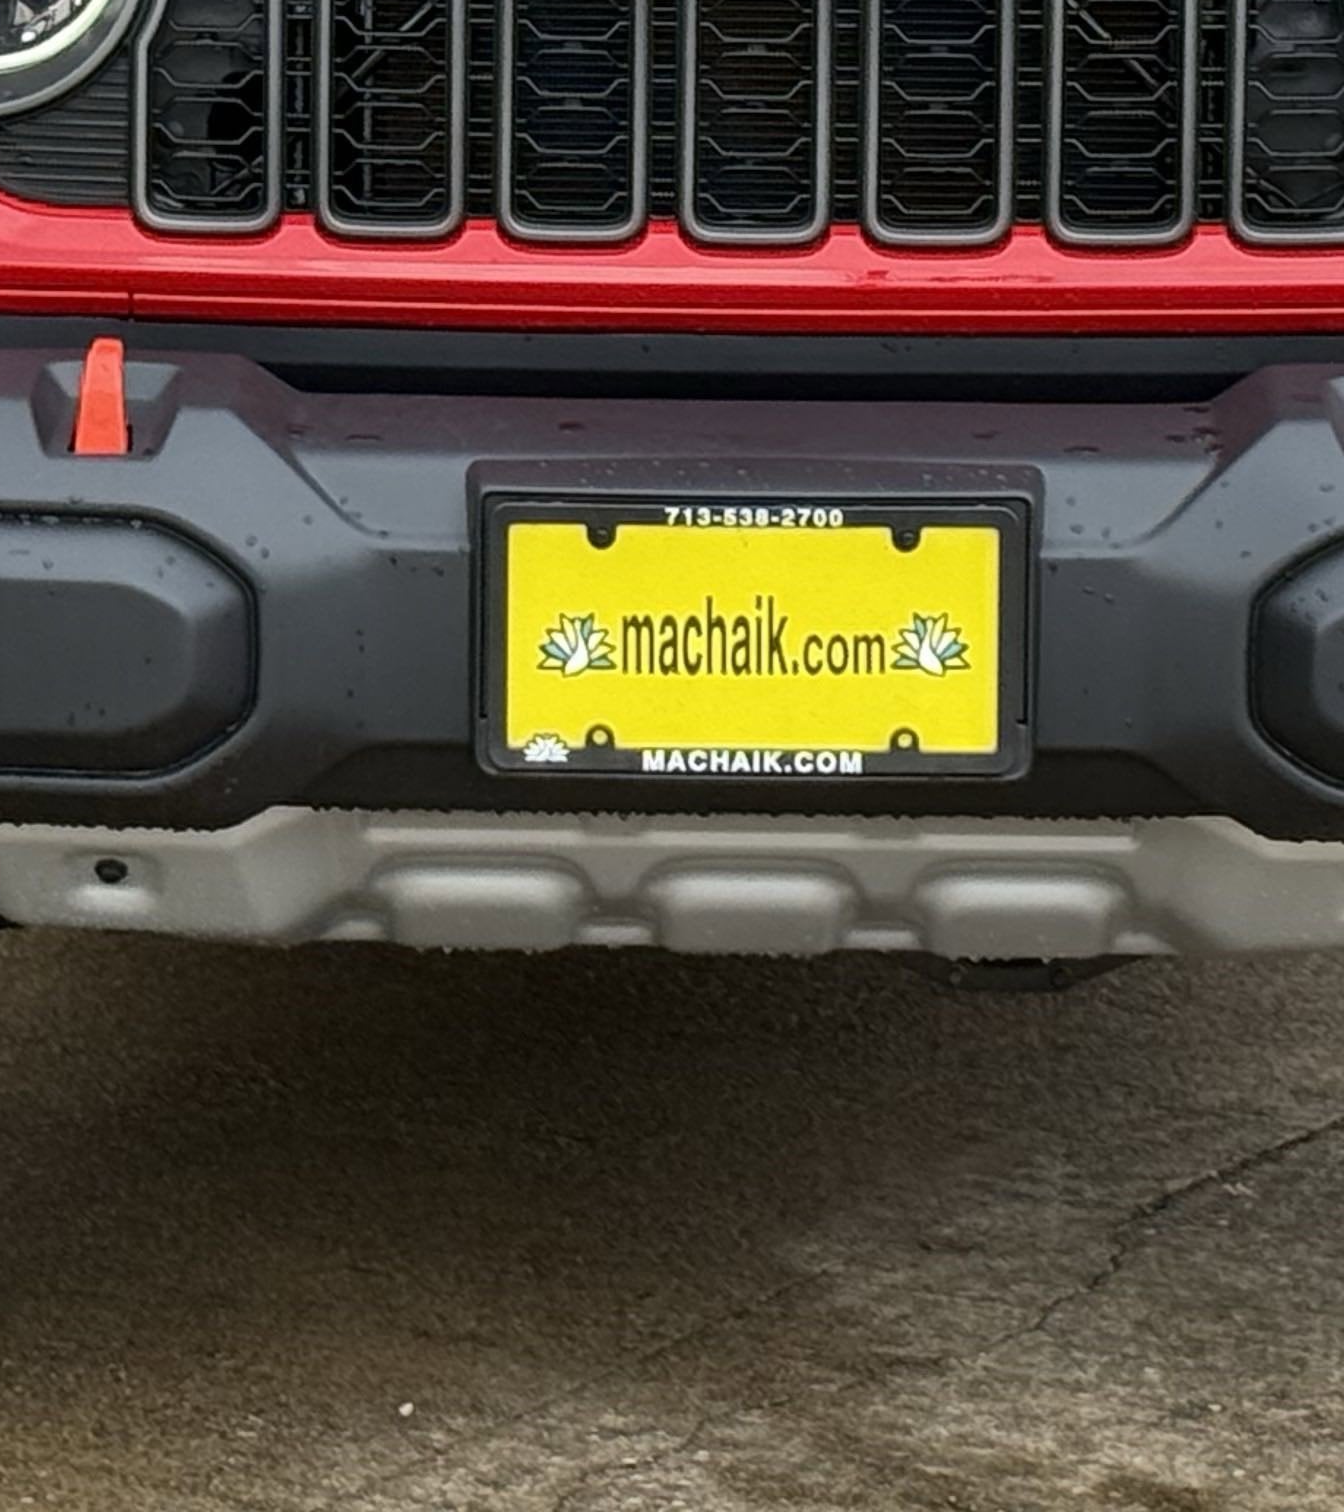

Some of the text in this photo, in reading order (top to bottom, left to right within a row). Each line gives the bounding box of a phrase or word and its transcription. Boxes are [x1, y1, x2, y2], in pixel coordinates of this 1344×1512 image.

[663, 507, 845, 528] 713-538-2700
[621, 596, 886, 676] machaik.com
[641, 751, 863, 774] MACHAIK.COM
